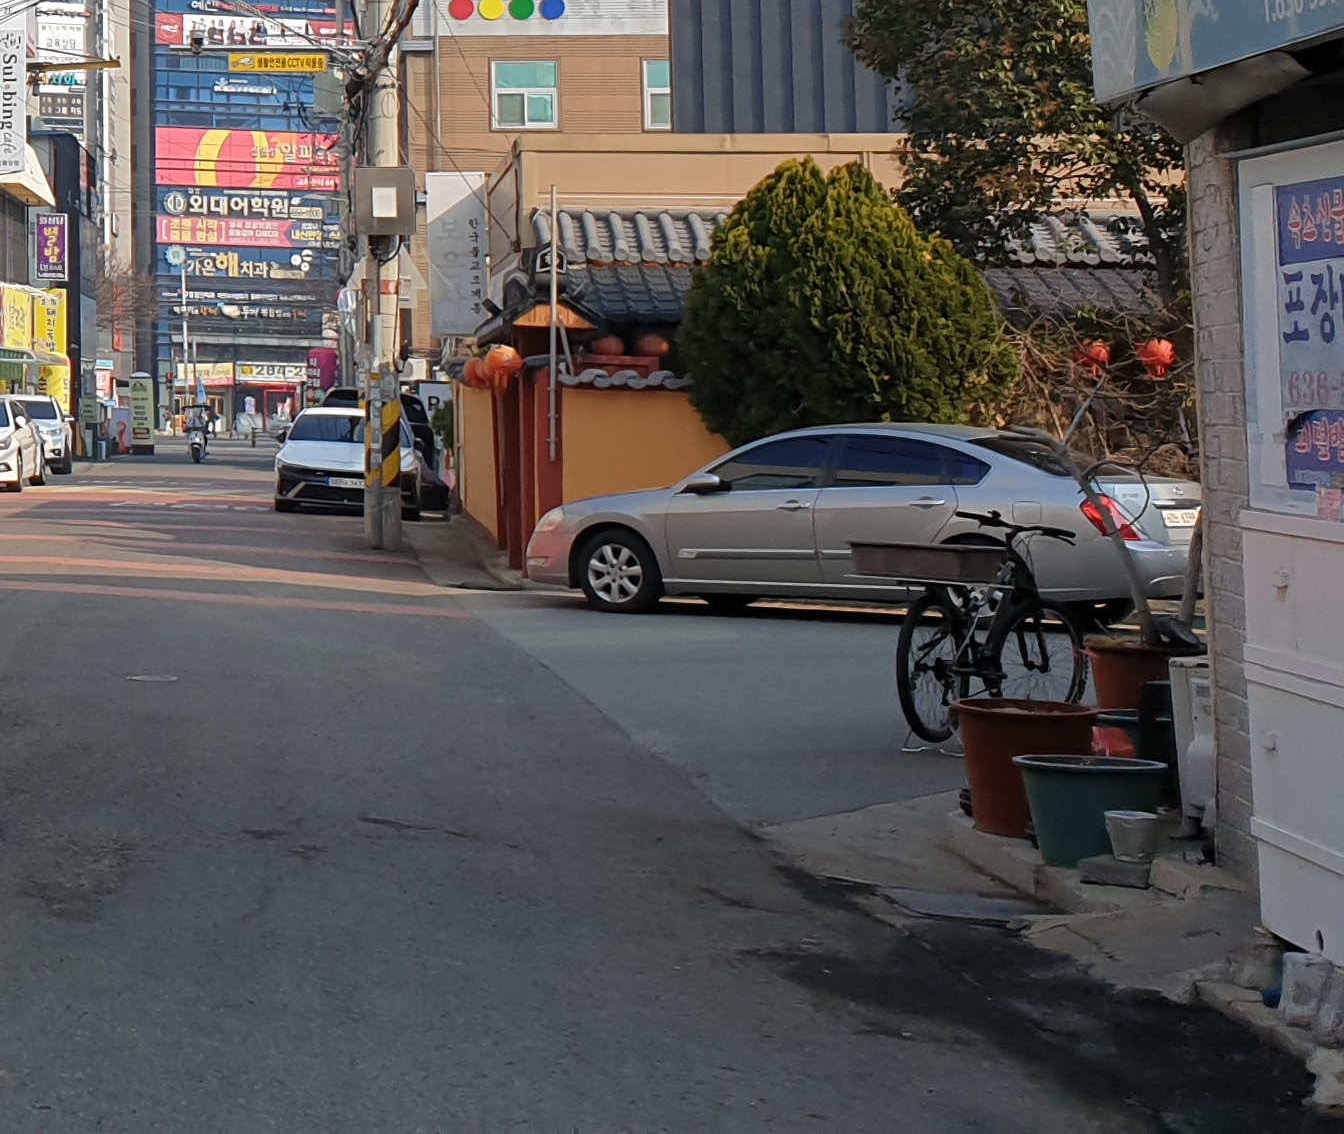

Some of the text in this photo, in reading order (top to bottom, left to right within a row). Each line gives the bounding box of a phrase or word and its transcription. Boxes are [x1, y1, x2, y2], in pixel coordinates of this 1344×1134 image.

[287, 56, 304, 69] CCTV
[188, 194, 289, 219] 외대어학원
[186, 251, 270, 278] 가온해치과
[1282, 263, 1344, 344] 포장
[428, 395, 441, 412] P
